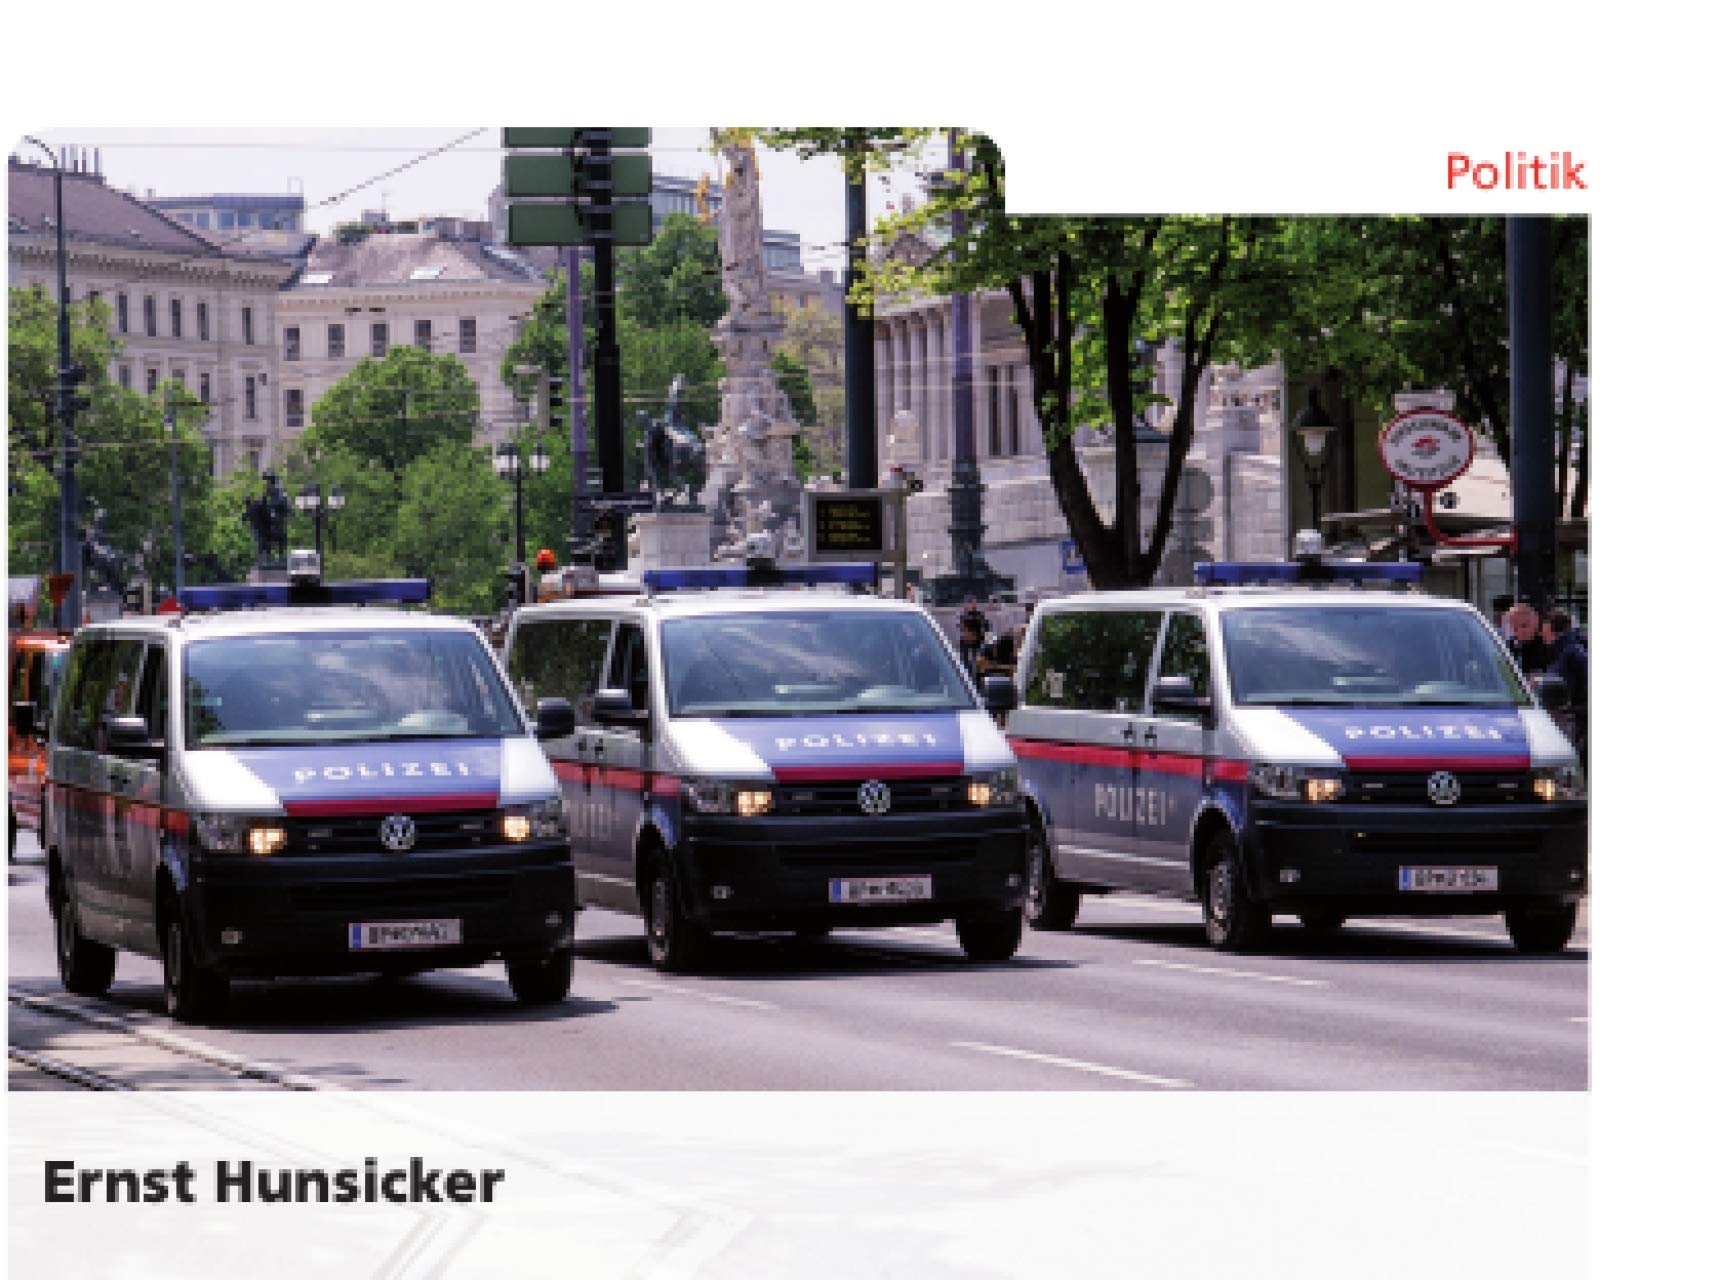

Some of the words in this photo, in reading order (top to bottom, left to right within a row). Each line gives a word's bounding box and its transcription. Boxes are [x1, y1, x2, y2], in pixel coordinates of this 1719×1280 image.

[774, 733, 938, 752] POLIZEI
[1345, 724, 1504, 741] POLIZEI
[293, 762, 470, 785] POLIZEI
[1094, 783, 1167, 827] POLIZEI
